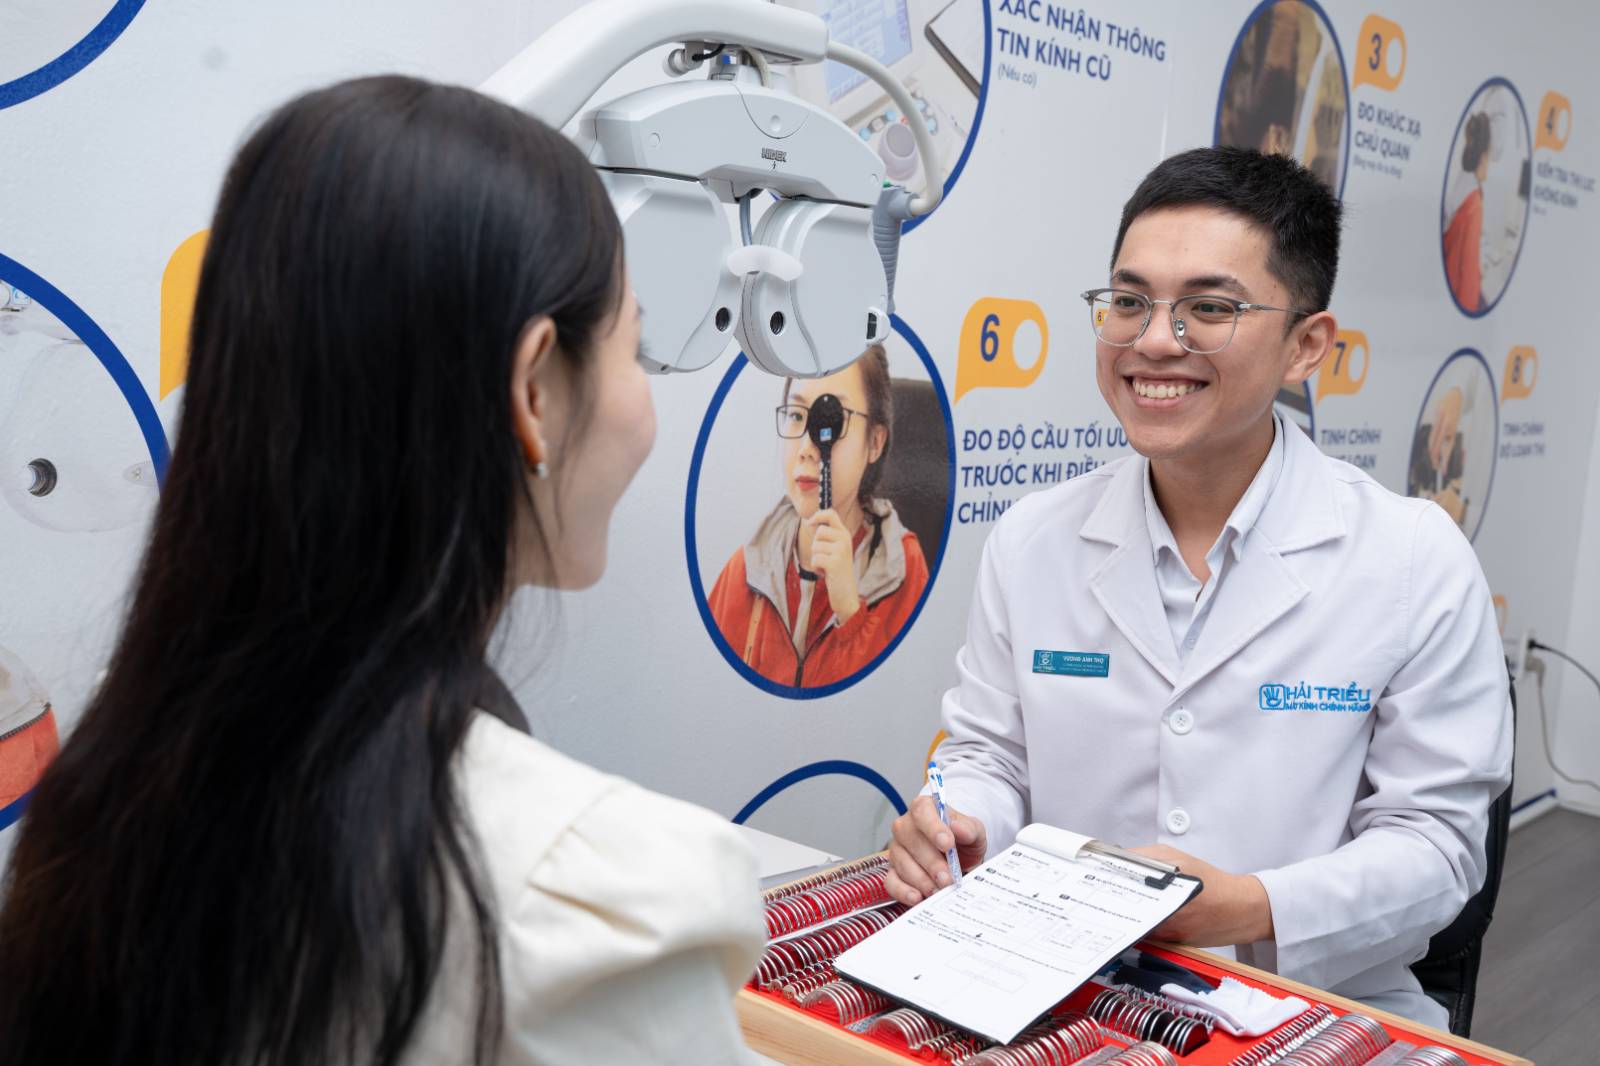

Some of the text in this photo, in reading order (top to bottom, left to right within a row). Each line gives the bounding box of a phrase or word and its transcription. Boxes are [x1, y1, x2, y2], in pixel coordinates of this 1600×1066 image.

[1046, 4, 1100, 42] NHẬN
[1106, 23, 1165, 62] THÔNG
[997, 28, 1112, 81] TIN KÍNH CŨ
[1369, 33, 1382, 71] 3
[1358, 101, 1375, 123] ĐO
[1545, 105, 1556, 136] 4
[1380, 138, 1411, 162] QUAN
[981, 313, 1000, 362] 6
[1334, 341, 1346, 376] 7
[1511, 354, 1522, 385] 8
[963, 429, 992, 451] ĐO
[997, 423, 1026, 456] ĐỘ
[1031, 420, 1069, 449] CẦU
[1074, 420, 1102, 448] TỐI
[961, 457, 1027, 488] TRƯỚC
[1032, 462, 1062, 484] KHI
[1286, 680, 1311, 700] HẢI
